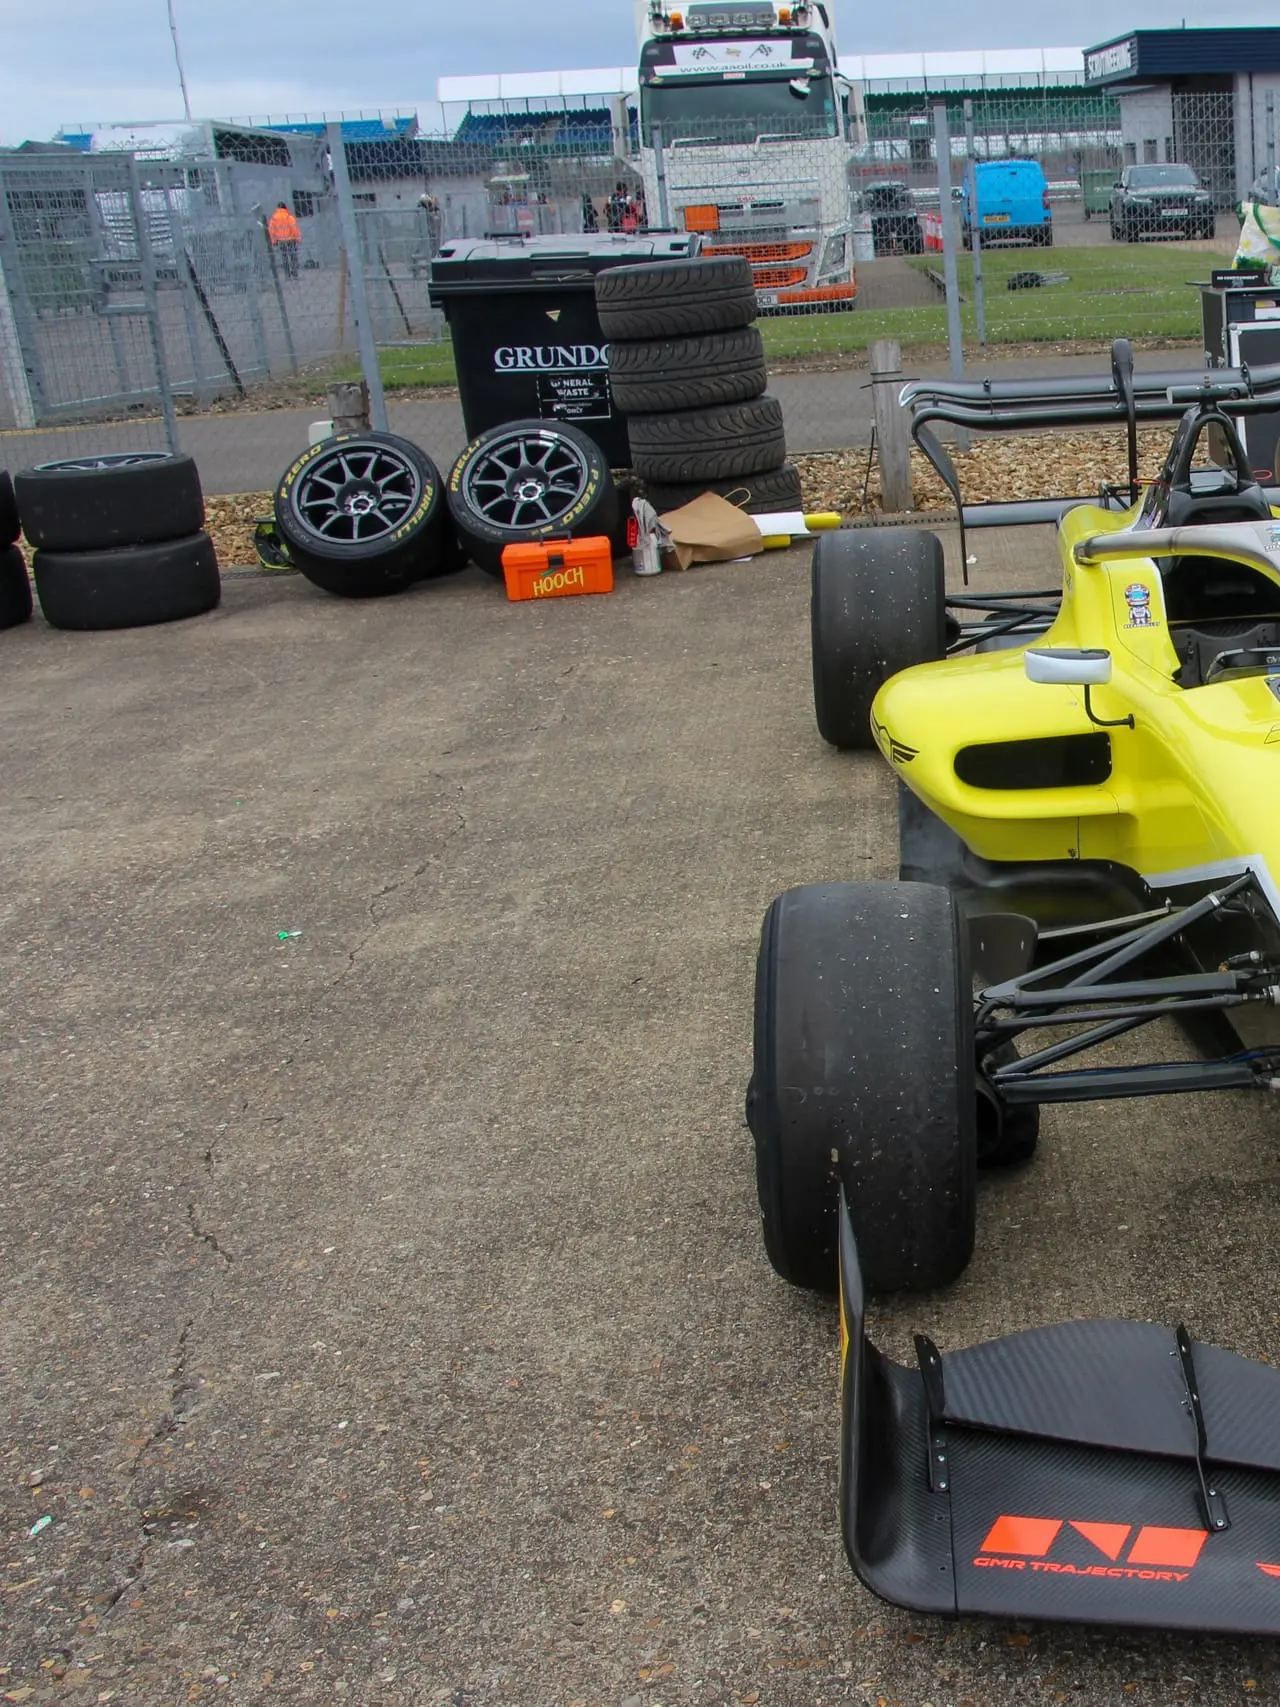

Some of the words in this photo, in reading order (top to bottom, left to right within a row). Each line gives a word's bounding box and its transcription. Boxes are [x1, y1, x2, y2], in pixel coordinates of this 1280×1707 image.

[680, 62, 788, 73] www.aaoil.co.uk
[556, 388, 589, 396] WASTE
[281, 487, 288, 498] P
[285, 445, 322, 485] ZERO
[451, 439, 481, 492] PIRELLI
[591, 468, 600, 481] P
[397, 485, 434, 538] PIRELLI
[562, 482, 598, 525] ZERO
[532, 566, 585, 597] HOOCH
[972, 1557, 1026, 1569] GMR
[1030, 1561, 1190, 1582] TRAJECTORY
